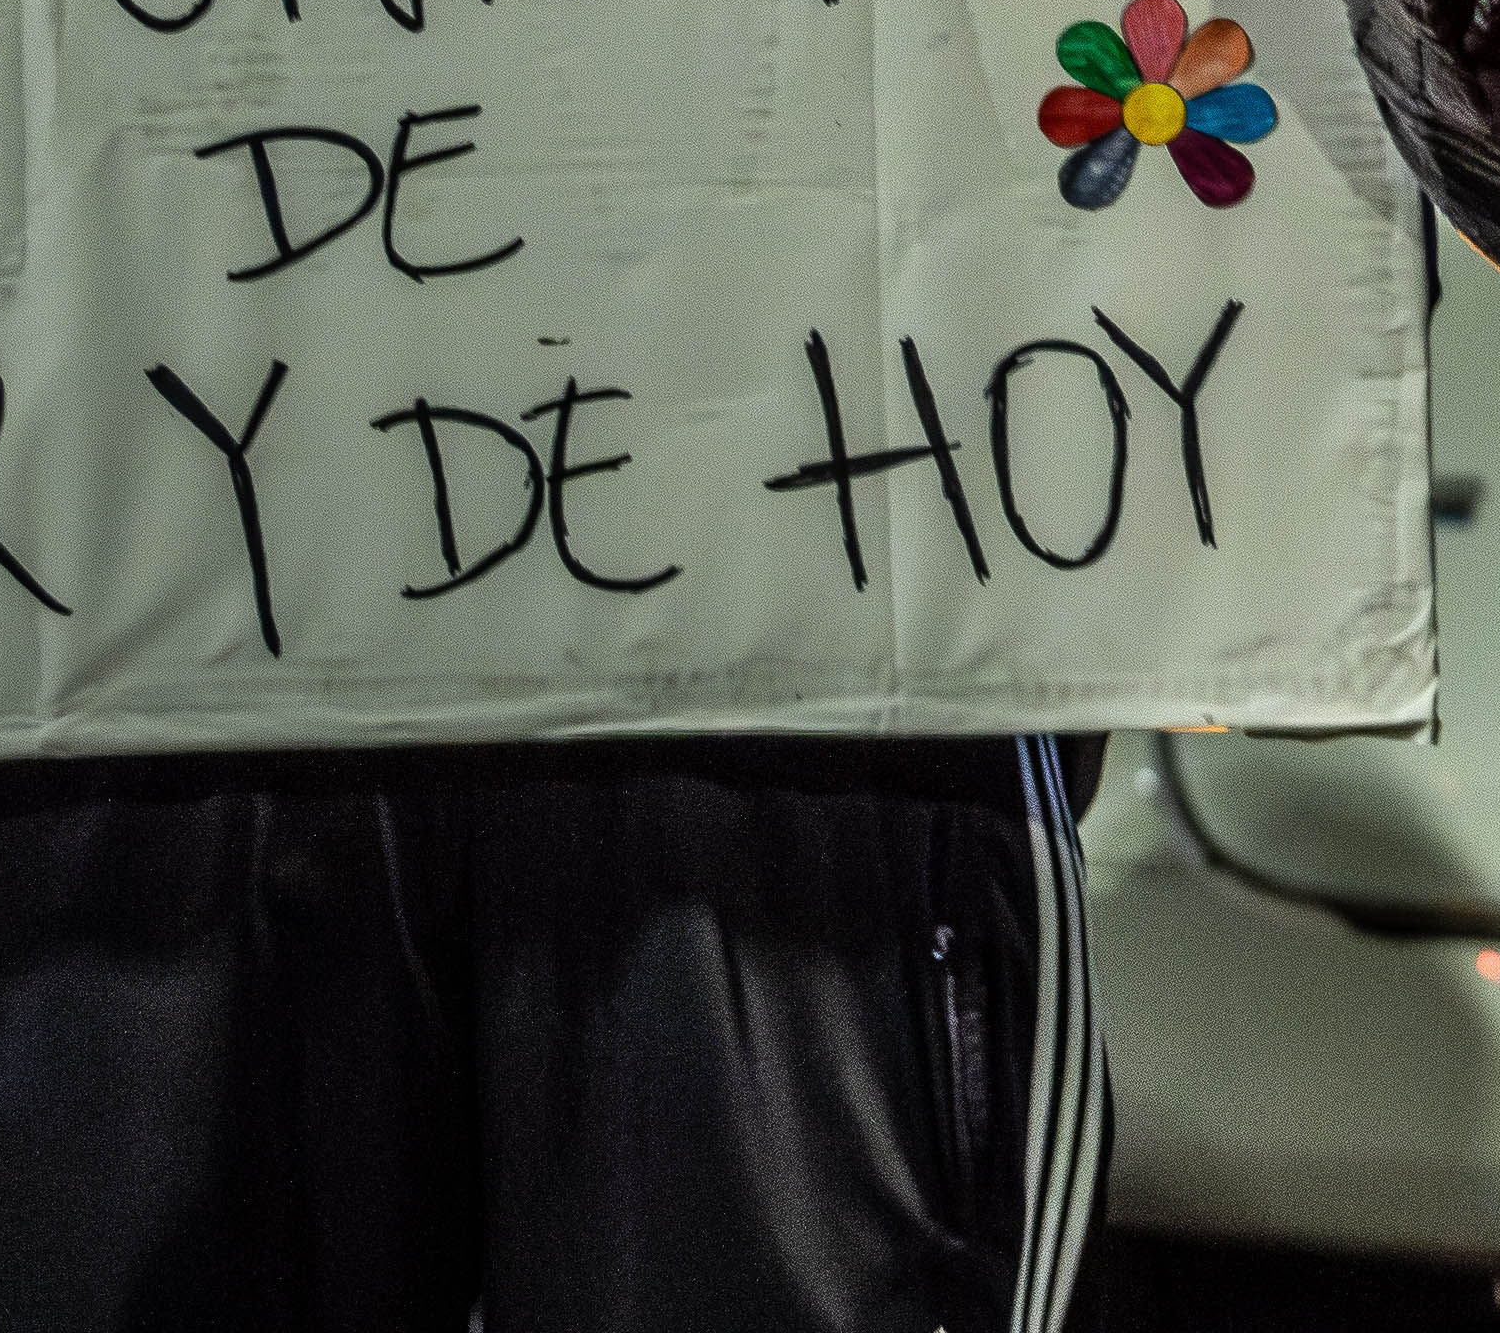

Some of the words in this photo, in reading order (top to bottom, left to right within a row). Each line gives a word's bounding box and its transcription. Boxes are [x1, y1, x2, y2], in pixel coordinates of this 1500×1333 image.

[192, 103, 528, 283] DE
[144, 357, 290, 657] Y
[763, 299, 1246, 593] HOY
